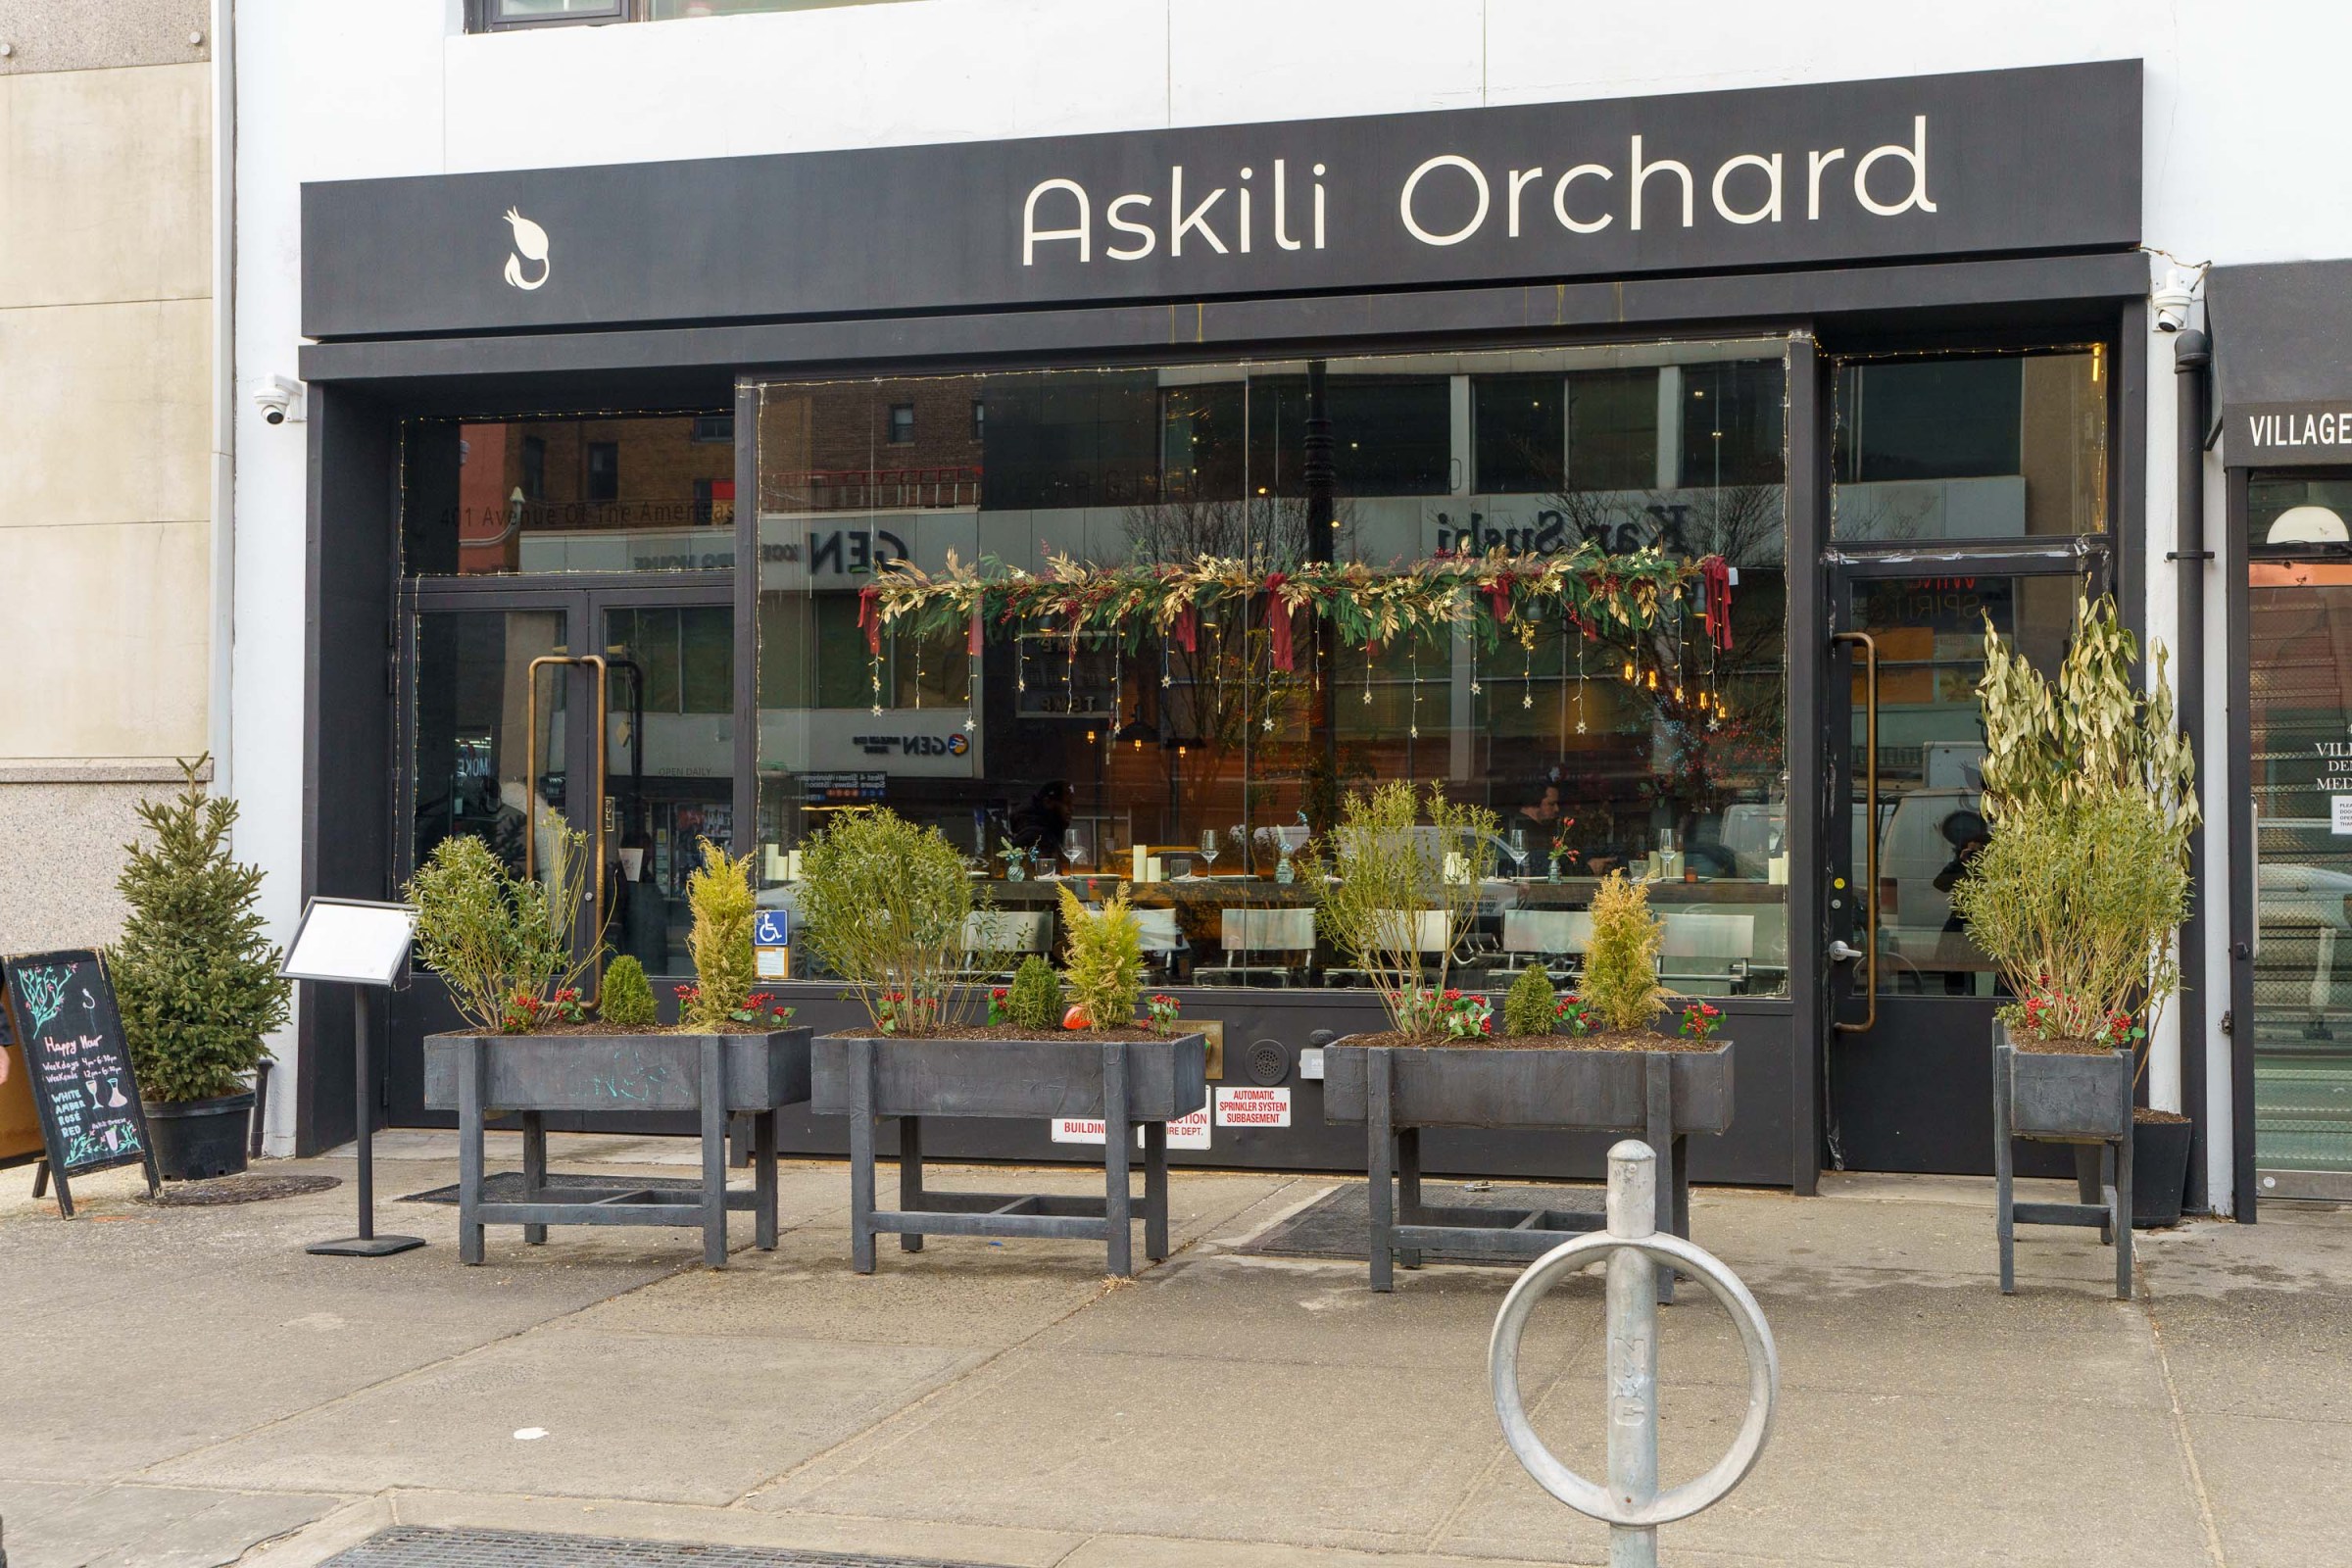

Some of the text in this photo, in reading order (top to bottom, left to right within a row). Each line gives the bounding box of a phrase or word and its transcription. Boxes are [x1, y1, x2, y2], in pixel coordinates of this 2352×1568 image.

[1022, 114, 1938, 268] Askili Orchard
[2249, 413, 2352, 447] VILLAGE
[482, 504, 556, 527] Avenue
[638, 499, 735, 522] Americas
[44, 1035, 103, 1056] Happy Hour
[51, 1089, 82, 1103] WHITE
[1233, 1090, 1275, 1101] AUTOMATIC
[55, 1099, 86, 1115] AMBER
[1219, 1101, 1287, 1112] SPRINKLER SYSTEM
[1226, 1113, 1281, 1124] SUBBASEMENT
[61, 1124, 81, 1138] RED
[1064, 1121, 1105, 1134] BUILDIN
[1166, 1126, 1204, 1137] IRE DEPT.
